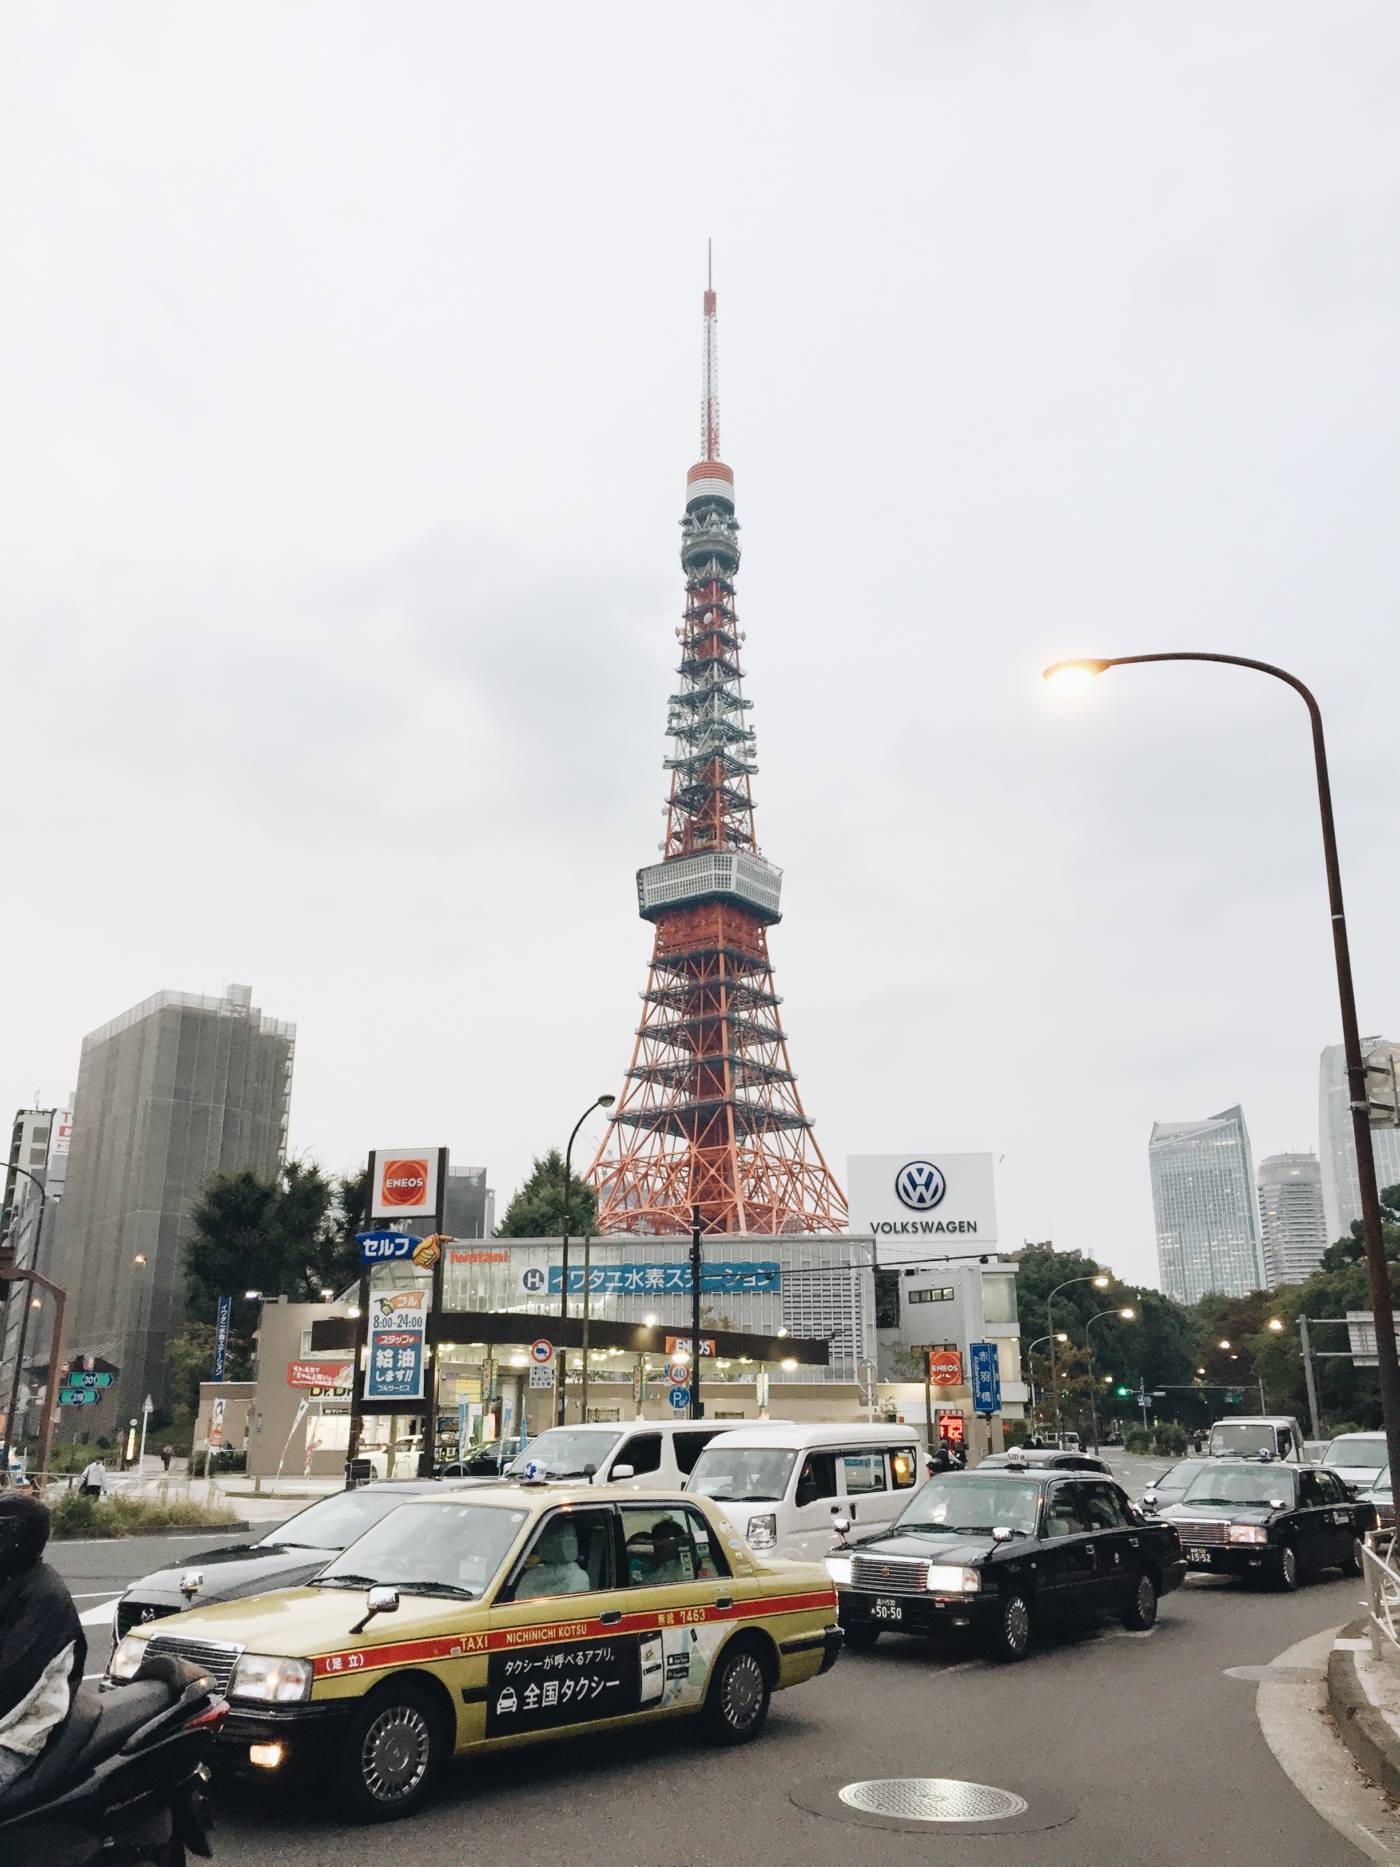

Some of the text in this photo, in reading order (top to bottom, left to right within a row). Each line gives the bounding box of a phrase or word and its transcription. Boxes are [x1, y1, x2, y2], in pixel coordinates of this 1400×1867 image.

[386, 1178, 423, 1188] ENEOS
[870, 1221, 977, 1234] VOLKSWAGEN
[363, 1238, 409, 1257] セルフ
[398, 1296, 417, 1307] フル
[380, 1335, 415, 1345] スタッフが
[675, 1339, 711, 1355] ENOS
[376, 1348, 416, 1368] 給油
[673, 1367, 686, 1378] 40
[931, 1364, 959, 1372] ENEOS
[84, 1376, 97, 1385] 301
[680, 1608, 706, 1623] 7463
[460, 1624, 587, 1651] TAXI NICHINICHI KOTSU
[504, 1648, 616, 1677] タクシーが呼べるアプリ。
[522, 1675, 621, 1711] 全国タクシー
